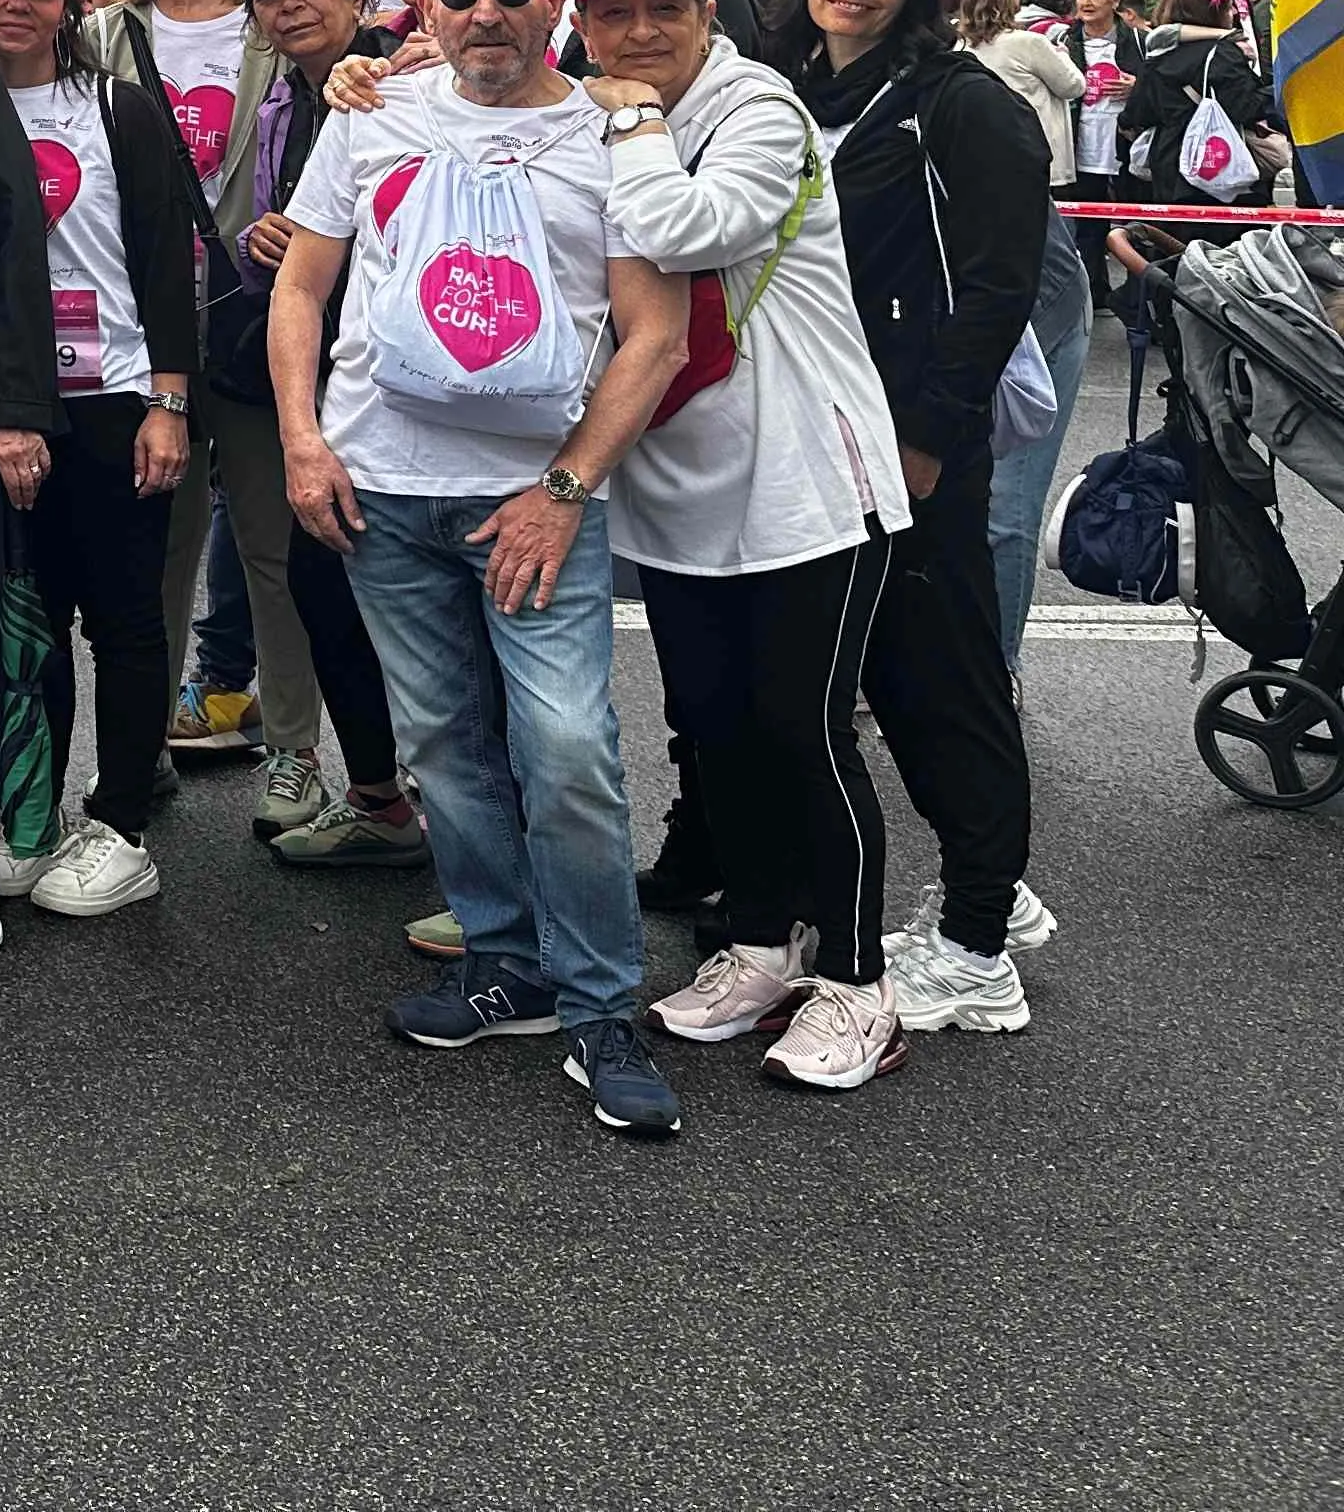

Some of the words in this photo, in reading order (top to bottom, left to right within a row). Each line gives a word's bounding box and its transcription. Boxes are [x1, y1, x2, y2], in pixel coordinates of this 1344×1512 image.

[173, 104, 202, 125] CE
[186, 128, 227, 150] THE
[432, 302, 498, 338] CURE
[468, 984, 518, 1026] N
